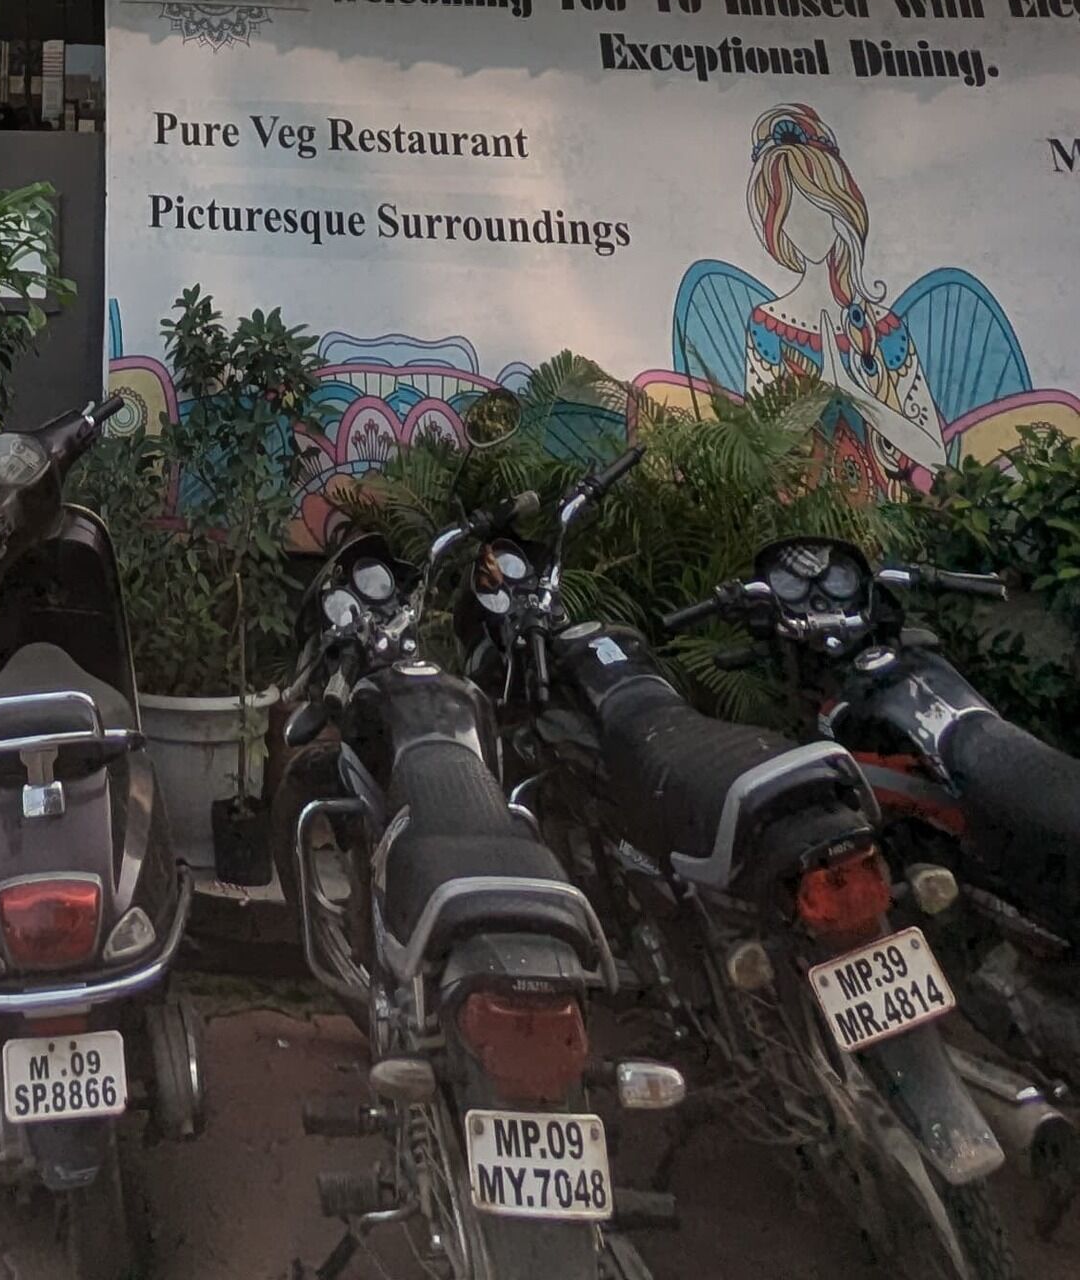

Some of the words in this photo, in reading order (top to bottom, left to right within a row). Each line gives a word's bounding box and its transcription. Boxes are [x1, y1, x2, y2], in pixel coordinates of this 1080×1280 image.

[599, 32, 830, 82] Exceptional
[849, 38, 999, 87] Dining.
[154, 112, 239, 147] Pure
[250, 115, 317, 159] Veg
[327, 117, 529, 159] Restaurant
[148, 194, 366, 245] Picturesque
[377, 203, 631, 257] Surroundings
[834, 945, 908, 1000] MP.39
[834, 974, 945, 1045] MR.4814
[15, 1076, 116, 1116] SP.8866
[494, 1118, 584, 1160] MP.09
[478, 1163, 606, 1209] MY.7048
